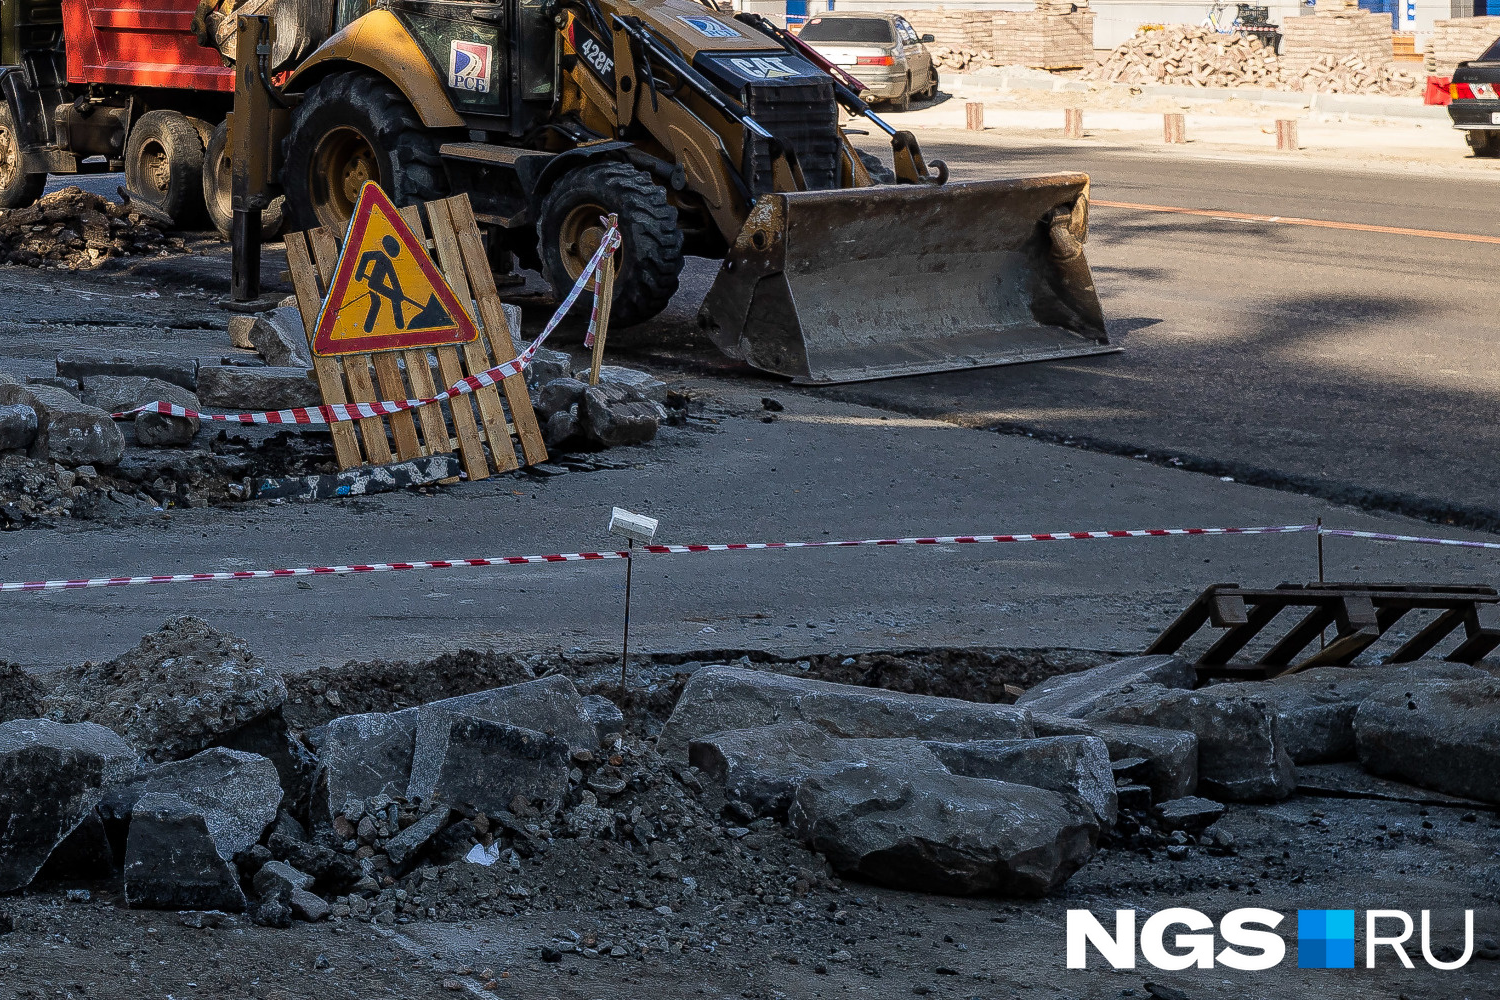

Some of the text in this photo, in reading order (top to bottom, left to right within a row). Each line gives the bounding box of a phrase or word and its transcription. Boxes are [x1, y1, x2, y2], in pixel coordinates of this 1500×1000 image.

[582, 38, 614, 75] 428F
[730, 57, 801, 78] CAT
[453, 75, 486, 92] РСБ
